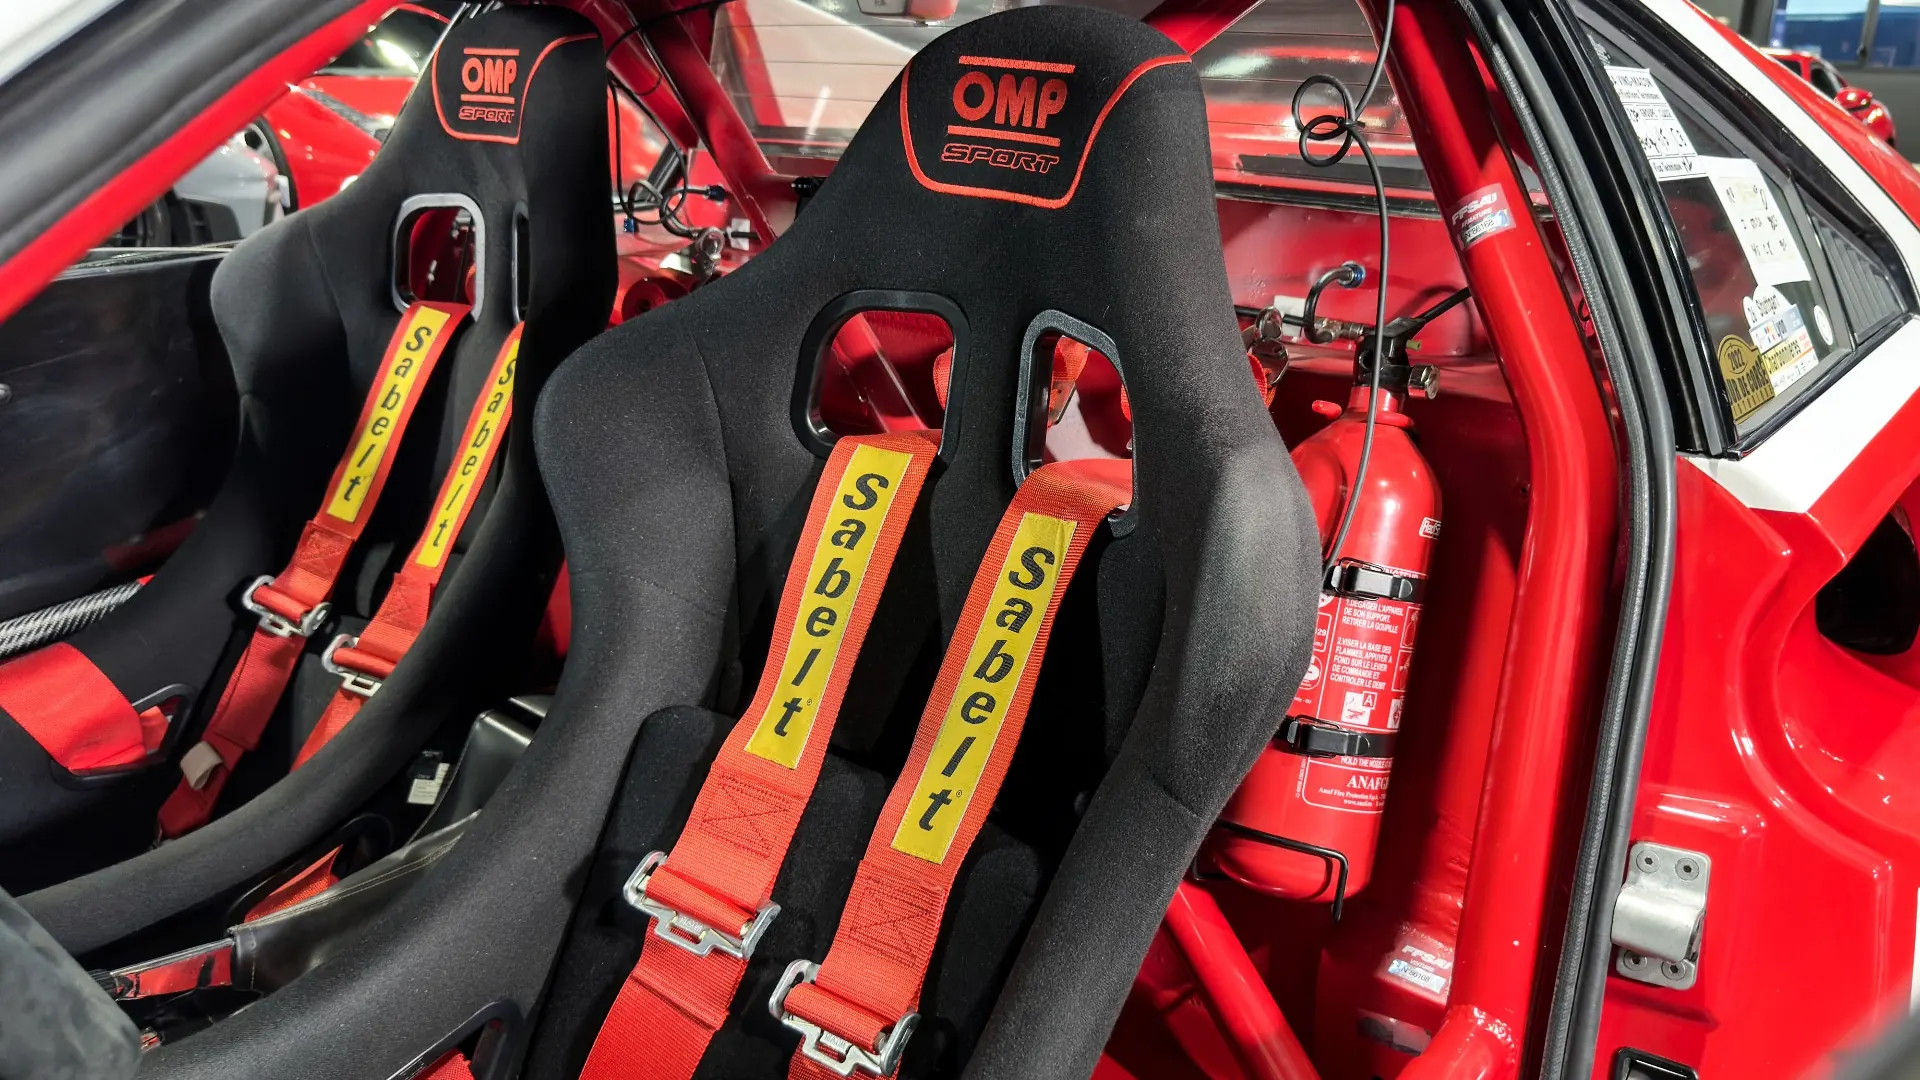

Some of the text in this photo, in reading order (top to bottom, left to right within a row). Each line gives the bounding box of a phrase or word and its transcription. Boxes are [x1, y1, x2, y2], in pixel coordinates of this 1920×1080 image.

[462, 57, 517, 94] OMP
[952, 70, 1068, 128] OMP
[458, 106, 516, 124] SPORT
[941, 142, 1060, 174] SPORT
[1728, 348, 1745, 371] 2022
[1738, 376, 1750, 398] DE
[1746, 354, 1769, 393] CORSE
[343, 326, 432, 502] Sabelt
[432, 358, 517, 548] Sabelt
[774, 472, 890, 738] Sabelt
[1353, 609, 1366, 618] SON
[1378, 603, 1404, 616] L'APPAREIL
[1342, 616, 1398, 634] RETIRER LA GOUPILLE
[1337, 637, 1392, 654] 2.VISER LA BASE DES
[1334, 655, 1351, 664] FOND
[1351, 657, 1362, 667] SUR
[1371, 662, 1387, 672] LEVIER
[1364, 651, 1388, 662] APPUYER
[1330, 673, 1365, 686] CONTROLER
[1332, 664, 1340, 672] DE
[1341, 665, 1372, 678] COMMANDE
[918, 546, 1056, 832] Sabelt
[1364, 694, 1373, 706] A
[1340, 756, 1358, 766] HOLD
[1358, 758, 1368, 766] THE
[1334, 789, 1344, 797] Fire
[1346, 790, 1368, 800] Protection
